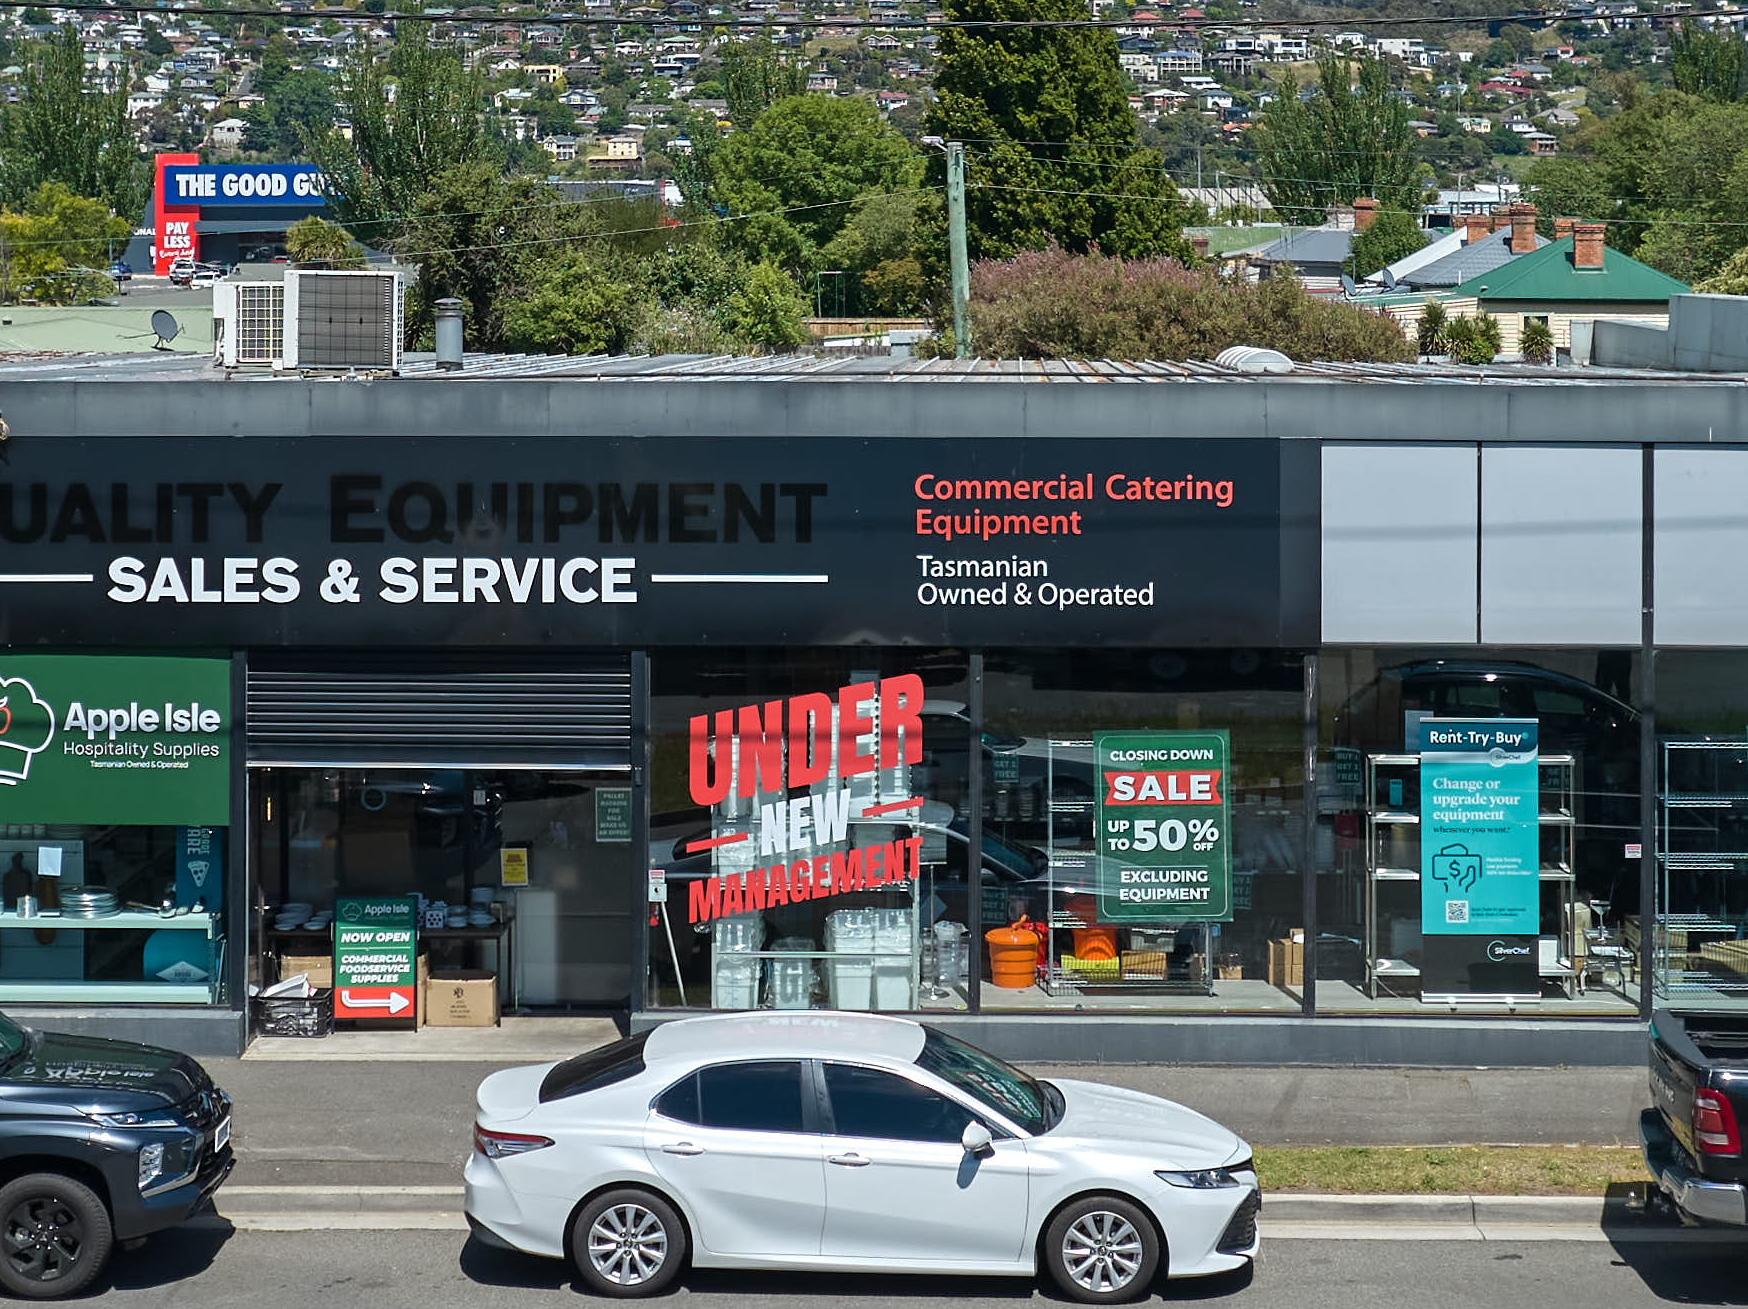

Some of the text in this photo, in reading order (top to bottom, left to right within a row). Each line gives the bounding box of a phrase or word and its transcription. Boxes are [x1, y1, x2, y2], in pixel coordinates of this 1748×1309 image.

[176, 174, 216, 197] THE
[222, 173, 287, 197] GOOD
[166, 222, 189, 234] PAY
[164, 236, 190, 248] LESS
[914, 473, 1234, 508] Commercial Catering
[329, 473, 829, 544] EQUIPMENT
[916, 509, 1082, 541] Equipment
[916, 555, 1048, 577] Tasmanian
[107, 556, 637, 604] SALES & SERVICE
[917, 582, 1154, 610] Owned & Operated
[63, 702, 221, 740] Apple Isle
[689, 673, 924, 806] UNDER
[63, 742, 220, 758] Hospitality Supplies
[1110, 750, 1213, 761] CLOSING DOWN
[157, 761, 188, 769] Operated
[1113, 775, 1212, 801] SALE
[1433, 777, 1500, 792] Change or
[1433, 793, 1521, 808] upgrade your
[761, 788, 851, 856] NEW
[1433, 808, 1504, 823] equipment
[1108, 820, 1130, 833] UP
[1108, 819, 1219, 852] TO 50%
[1193, 843, 1214, 851] OFF
[688, 836, 923, 923] MANAGEMENT
[1120, 870, 1208, 883] EXCLUDING
[1119, 888, 1210, 902] EQUIPMENT
[364, 903, 409, 915] Apple Isle
[341, 932, 411, 942] NOW OPEN
[341, 954, 408, 963] COMMERCIAL
[339, 964, 410, 973] FOODSERVICE
[351, 975, 398, 983] SUPPLIES
